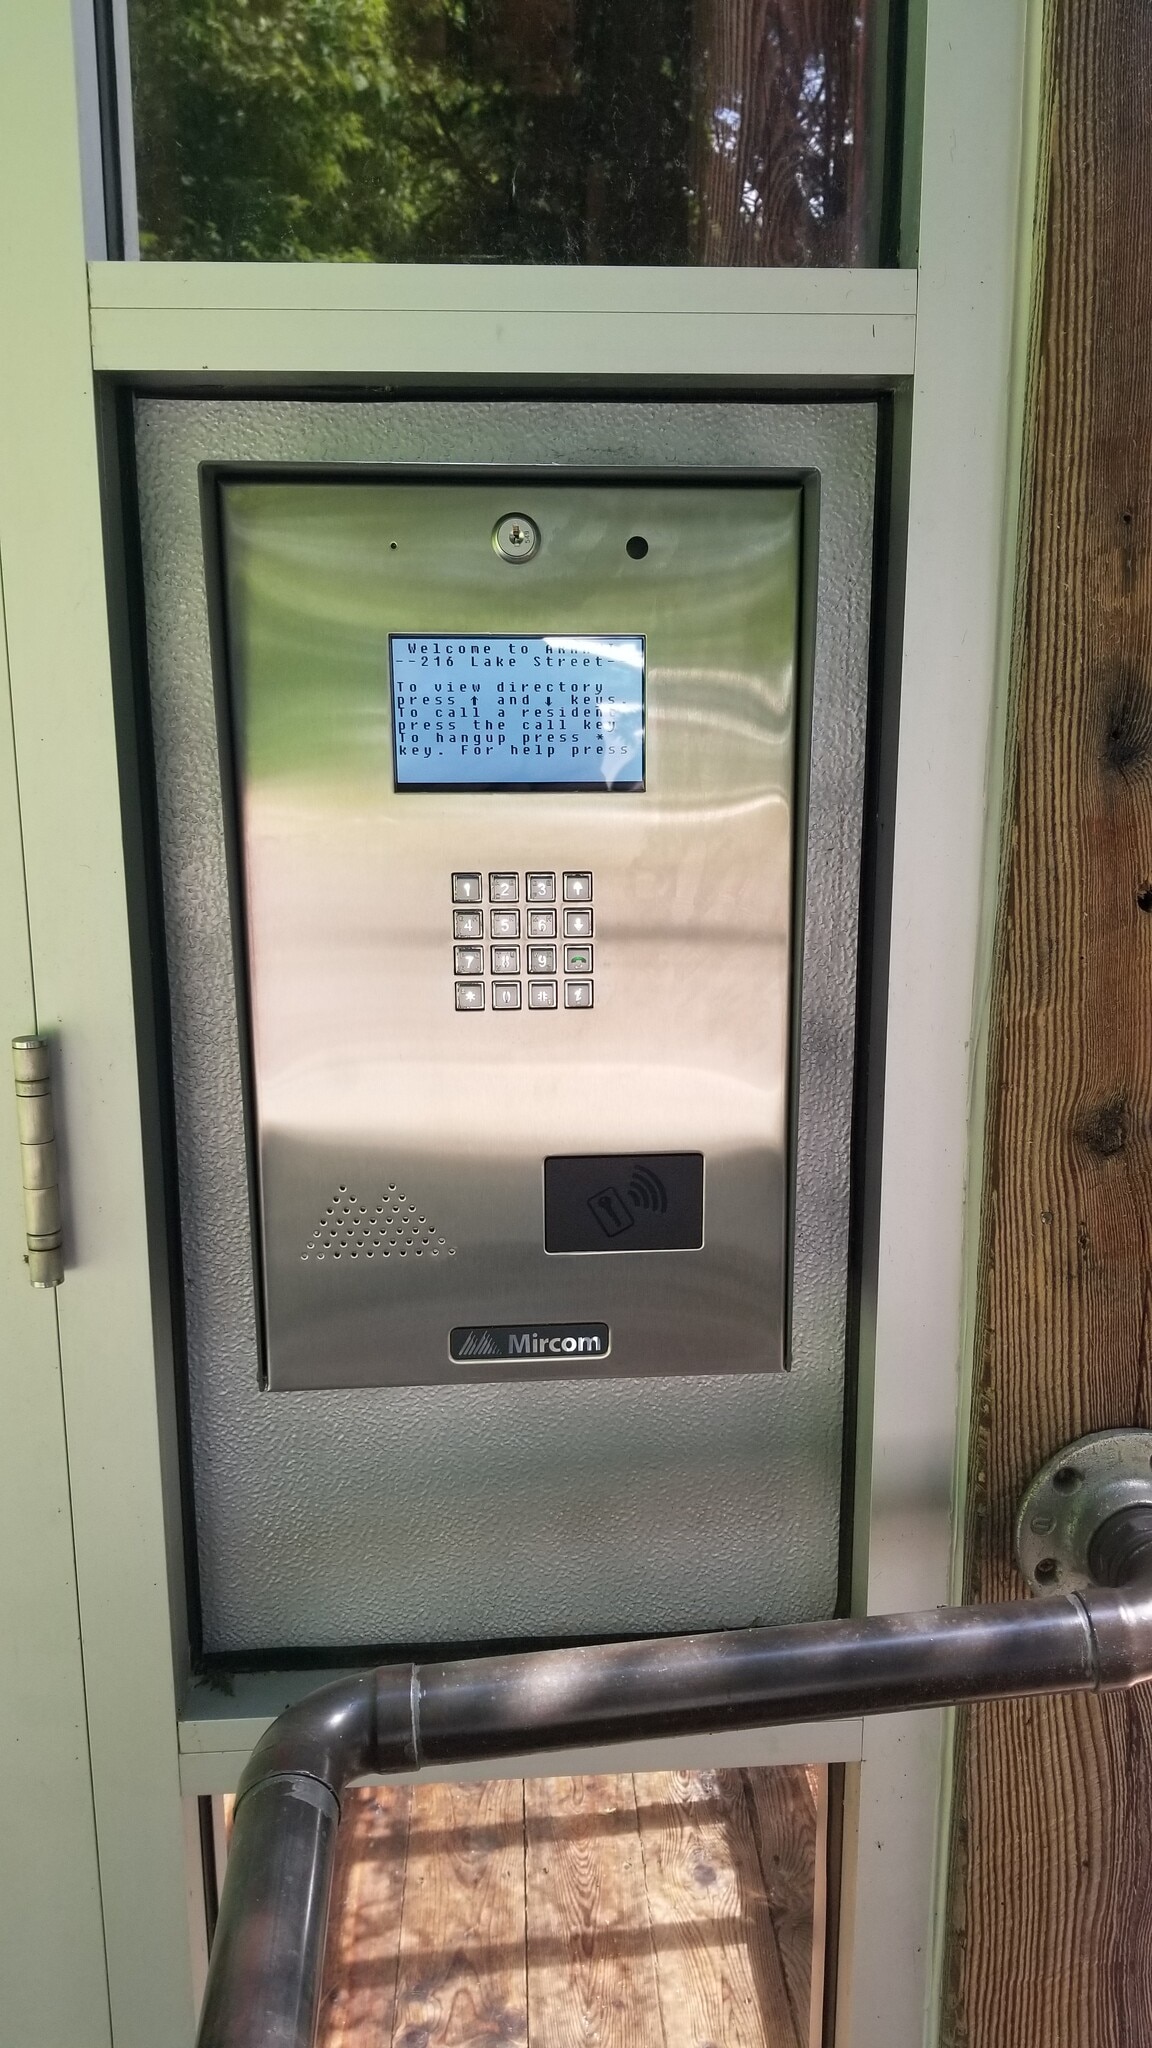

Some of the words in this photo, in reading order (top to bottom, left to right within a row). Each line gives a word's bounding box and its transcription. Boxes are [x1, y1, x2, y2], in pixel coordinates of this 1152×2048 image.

[408, 643, 491, 654] Welcome
[508, 643, 529, 654] to
[471, 656, 517, 667] Lake
[397, 682, 417, 693] To
[434, 682, 481, 692] view
[497, 681, 603, 694] directory
[397, 695, 456, 708] press
[497, 694, 530, 705] and
[398, 708, 419, 718] To
[435, 707, 481, 718] call
[498, 709, 505, 718] a
[398, 720, 457, 734] press
[474, 720, 506, 730] the
[522, 720, 567, 730] call
[583, 720, 616, 732] key
[399, 733, 419, 743] To
[436, 732, 506, 745] hangup
[522, 733, 579, 745] press
[399, 745, 444, 758] key.
[461, 745, 494, 756] For
[511, 745, 555, 757] help
[572, 745, 628, 757] press
[464, 883, 472, 897] 1
[501, 884, 510, 896] 2
[538, 883, 547, 896] 3
[464, 919, 473, 932] 4
[501, 919, 510, 932] 5
[538, 920, 547, 932] 6
[465, 956, 474, 969] 7
[502, 956, 511, 968] 8
[538, 955, 548, 968] 9
[508, 1333, 601, 1354] Mircom
